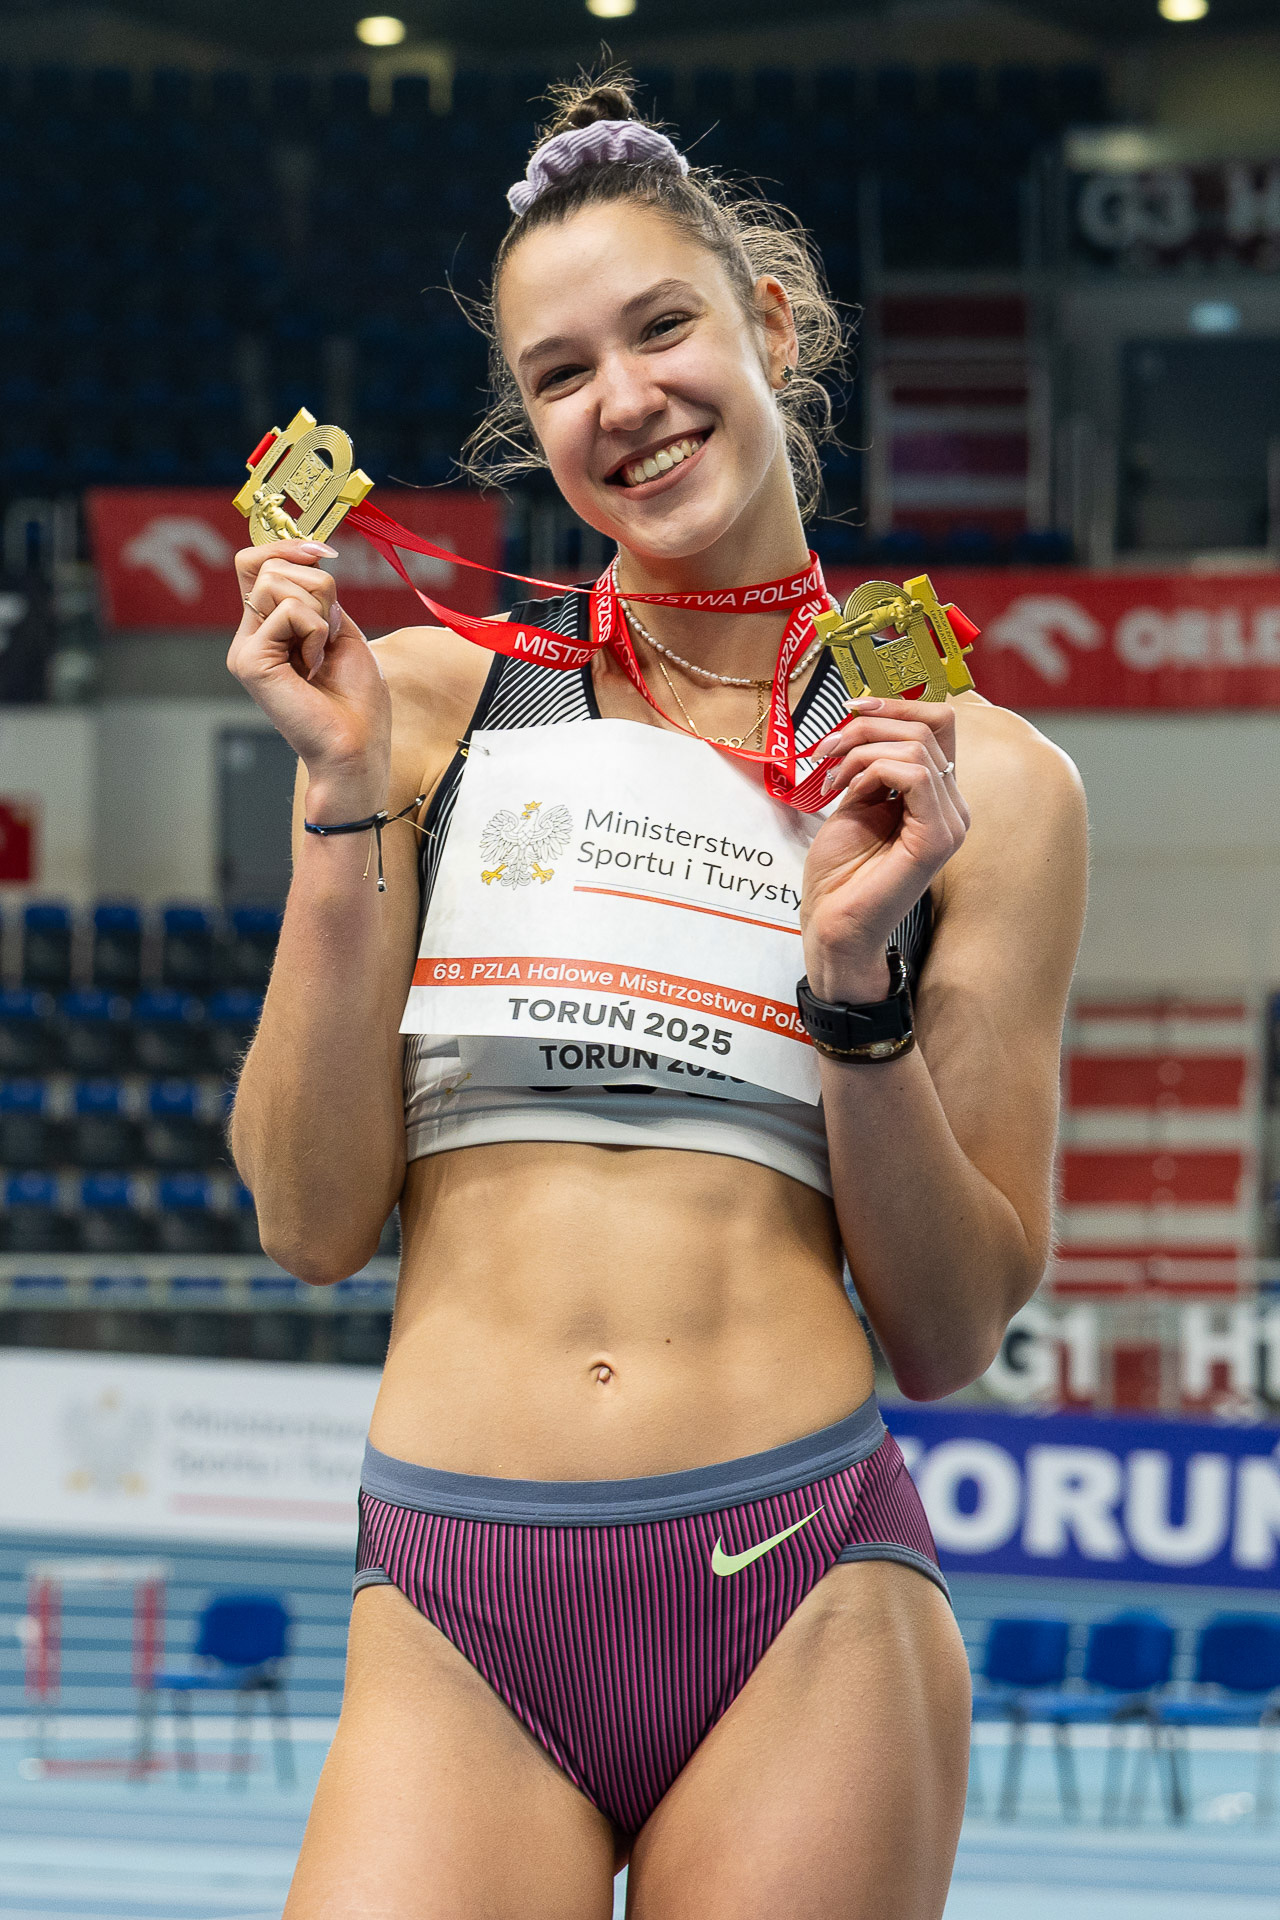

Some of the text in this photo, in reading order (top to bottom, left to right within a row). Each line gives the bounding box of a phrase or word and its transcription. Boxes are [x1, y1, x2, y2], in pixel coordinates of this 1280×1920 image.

[743, 571, 818, 607] POLSKI
[577, 841, 675, 877] Sportu
[684, 858, 693, 880] i
[584, 808, 774, 867] Ministerstwo
[433, 963, 810, 1036] 69. PZLA Halowe Mistrzostwa Pols
[508, 998, 733, 1056] TORUŃ 2025
